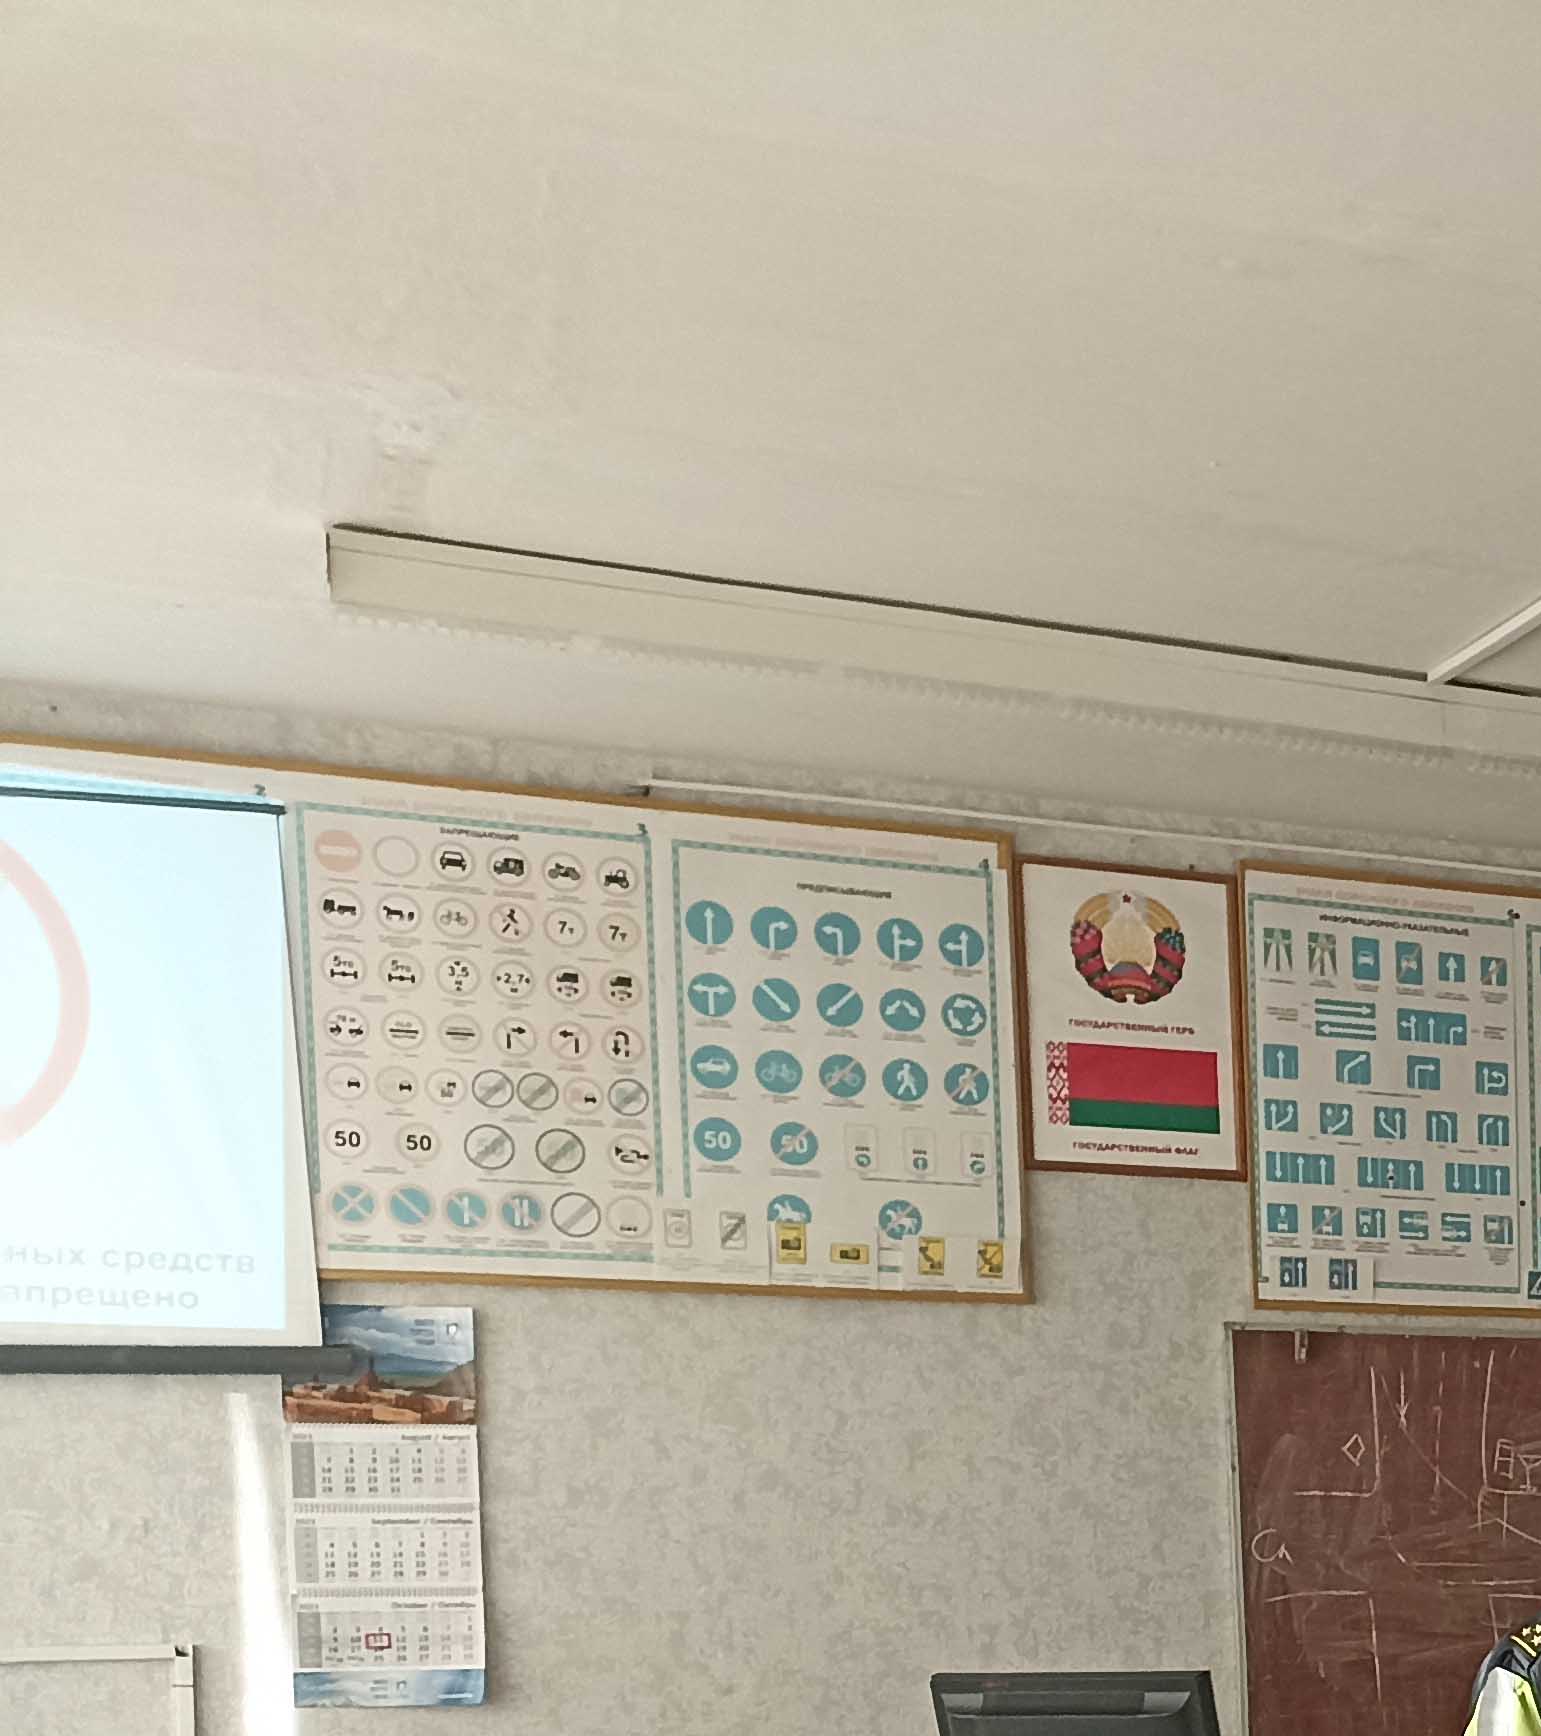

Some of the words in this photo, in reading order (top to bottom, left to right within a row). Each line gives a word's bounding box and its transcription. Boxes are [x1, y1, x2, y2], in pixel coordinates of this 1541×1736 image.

[1068, 1018, 1169, 1034] ГОСУДАРСТВЕННЫЙ
[334, 1130, 361, 1148] 50
[406, 1134, 432, 1152] 50
[704, 1131, 731, 1149] 50
[101, 1248, 256, 1276] средств
